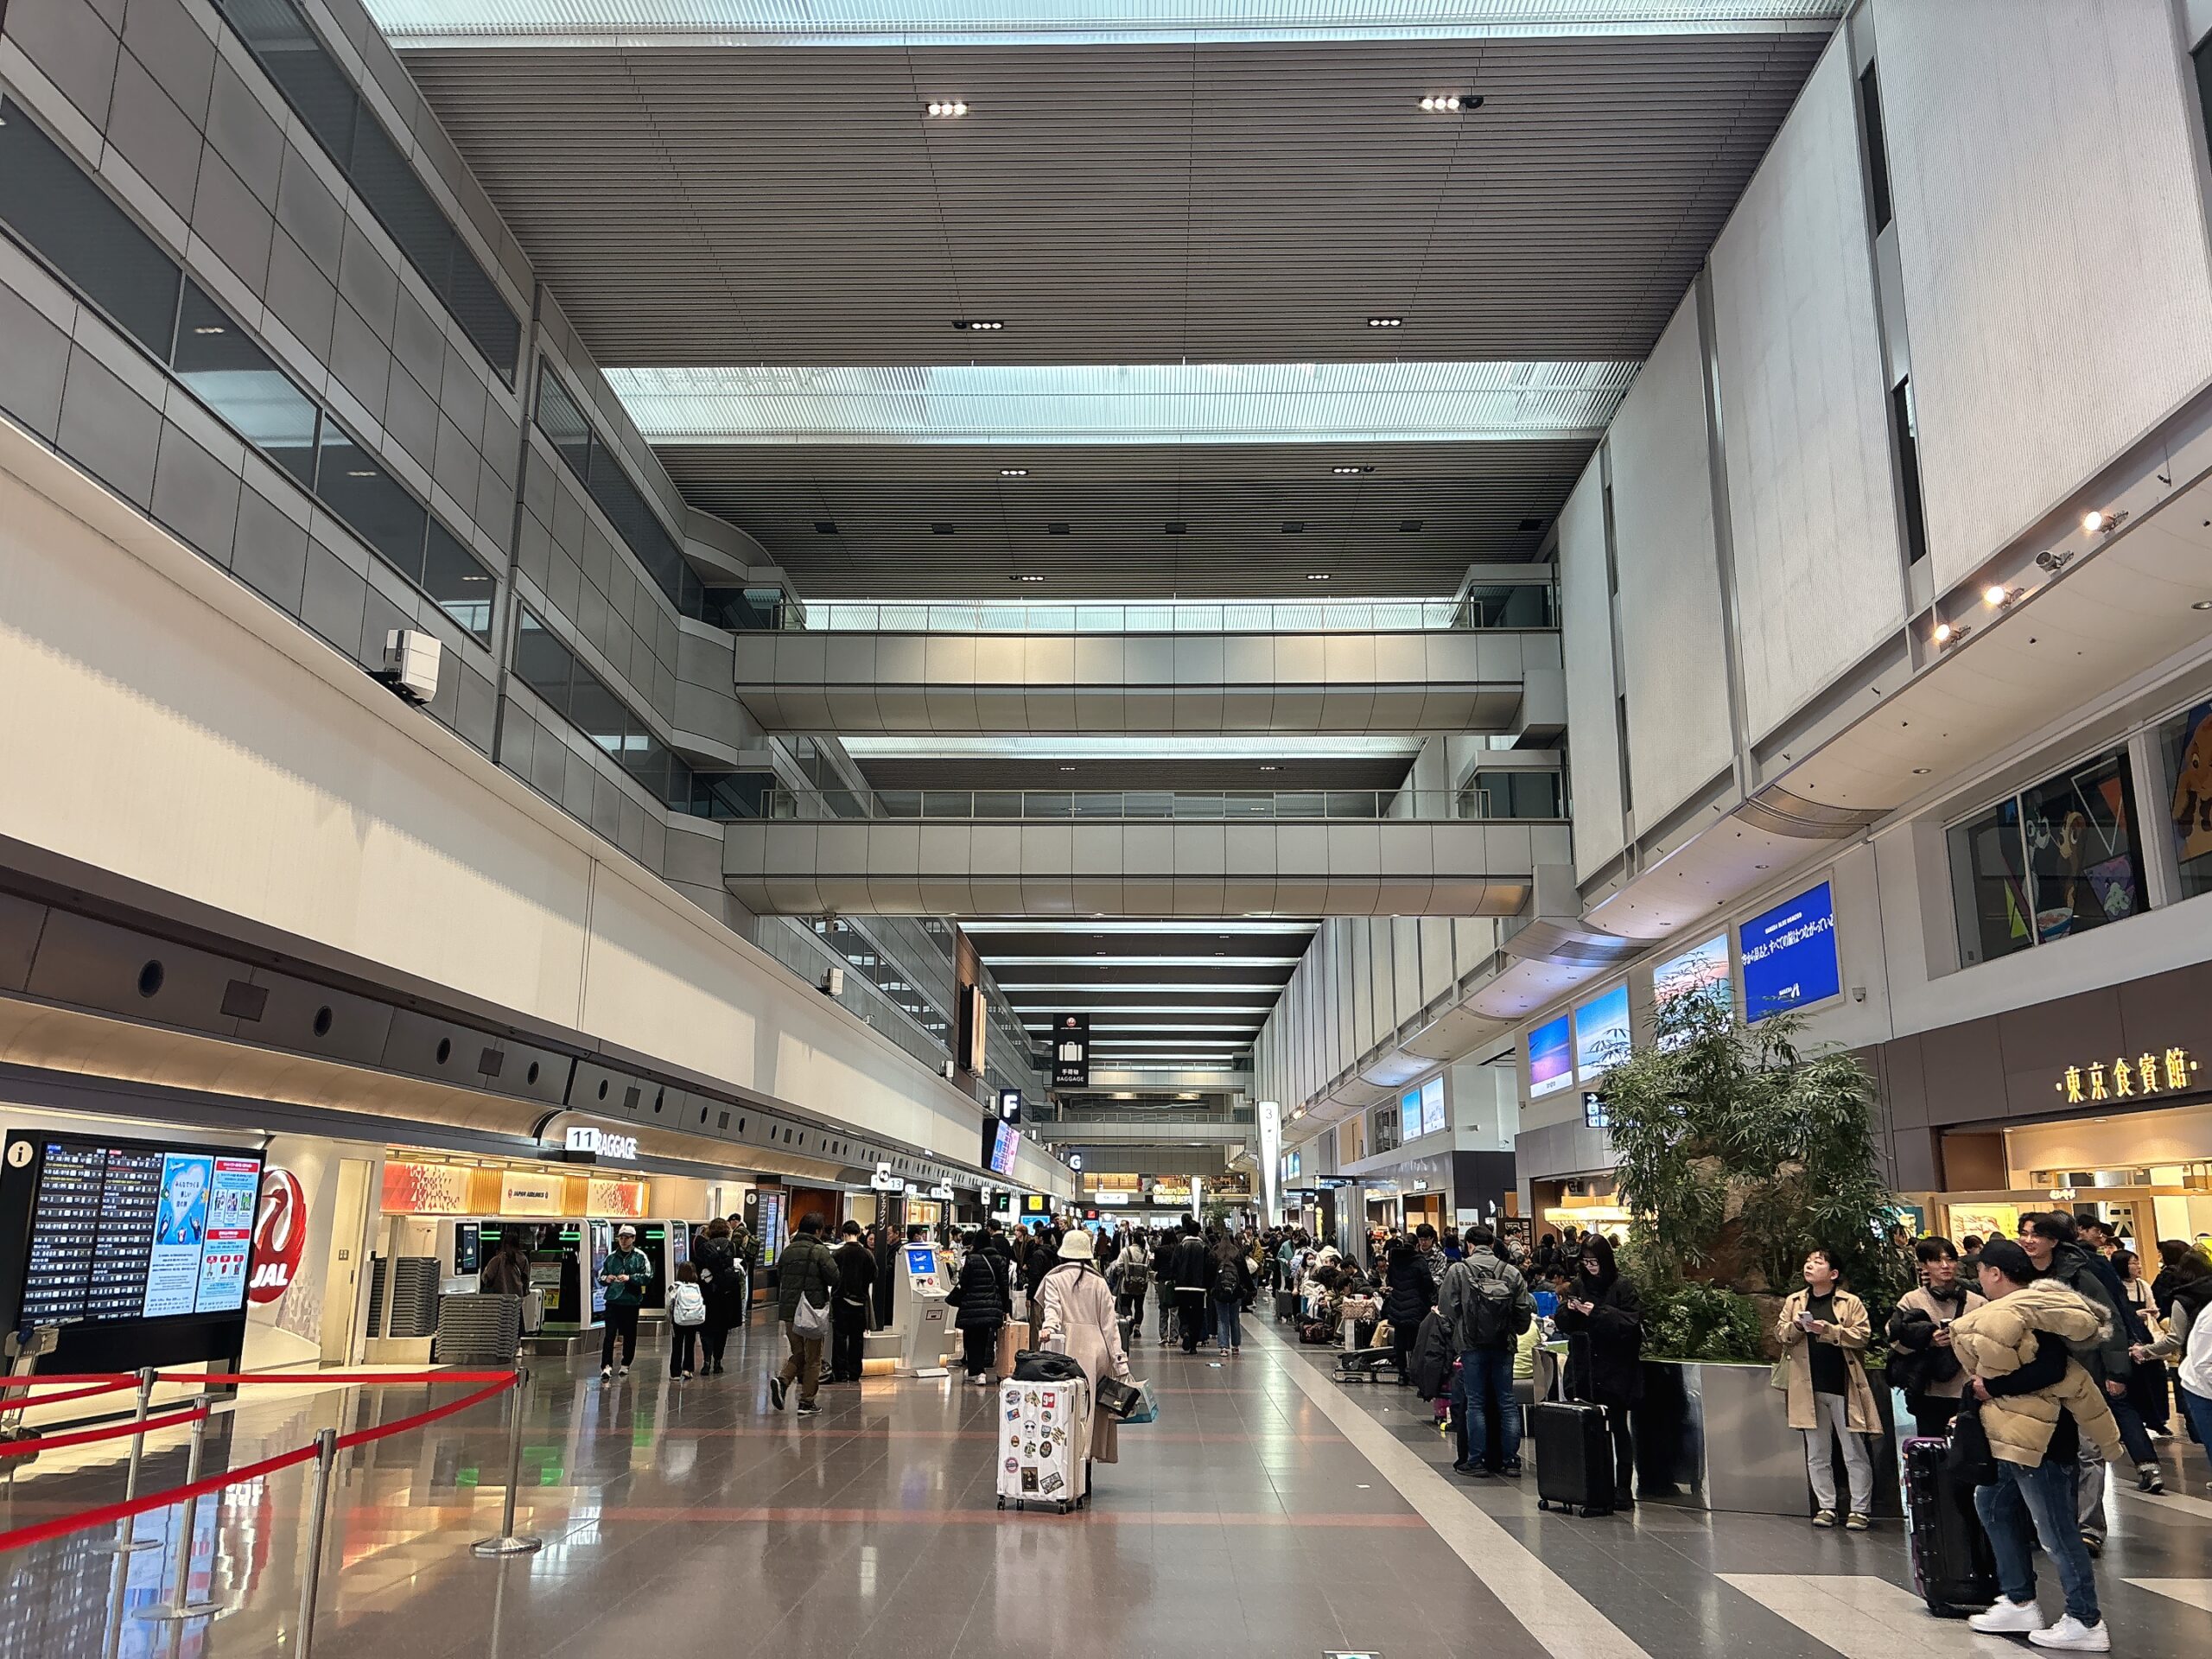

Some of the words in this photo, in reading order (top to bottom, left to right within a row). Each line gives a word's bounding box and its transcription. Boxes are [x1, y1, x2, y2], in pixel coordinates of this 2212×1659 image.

[1003, 1095, 1018, 1118] F
[1266, 1108, 1273, 1120] 3
[573, 1131, 594, 1148] 11
[595, 1132, 638, 1160] BAGGAGE
[1070, 1154, 1081, 1170] G
[891, 1179, 901, 1189] 13
[1000, 1197, 1007, 1210] F
[250, 1262, 289, 1288] JAL
